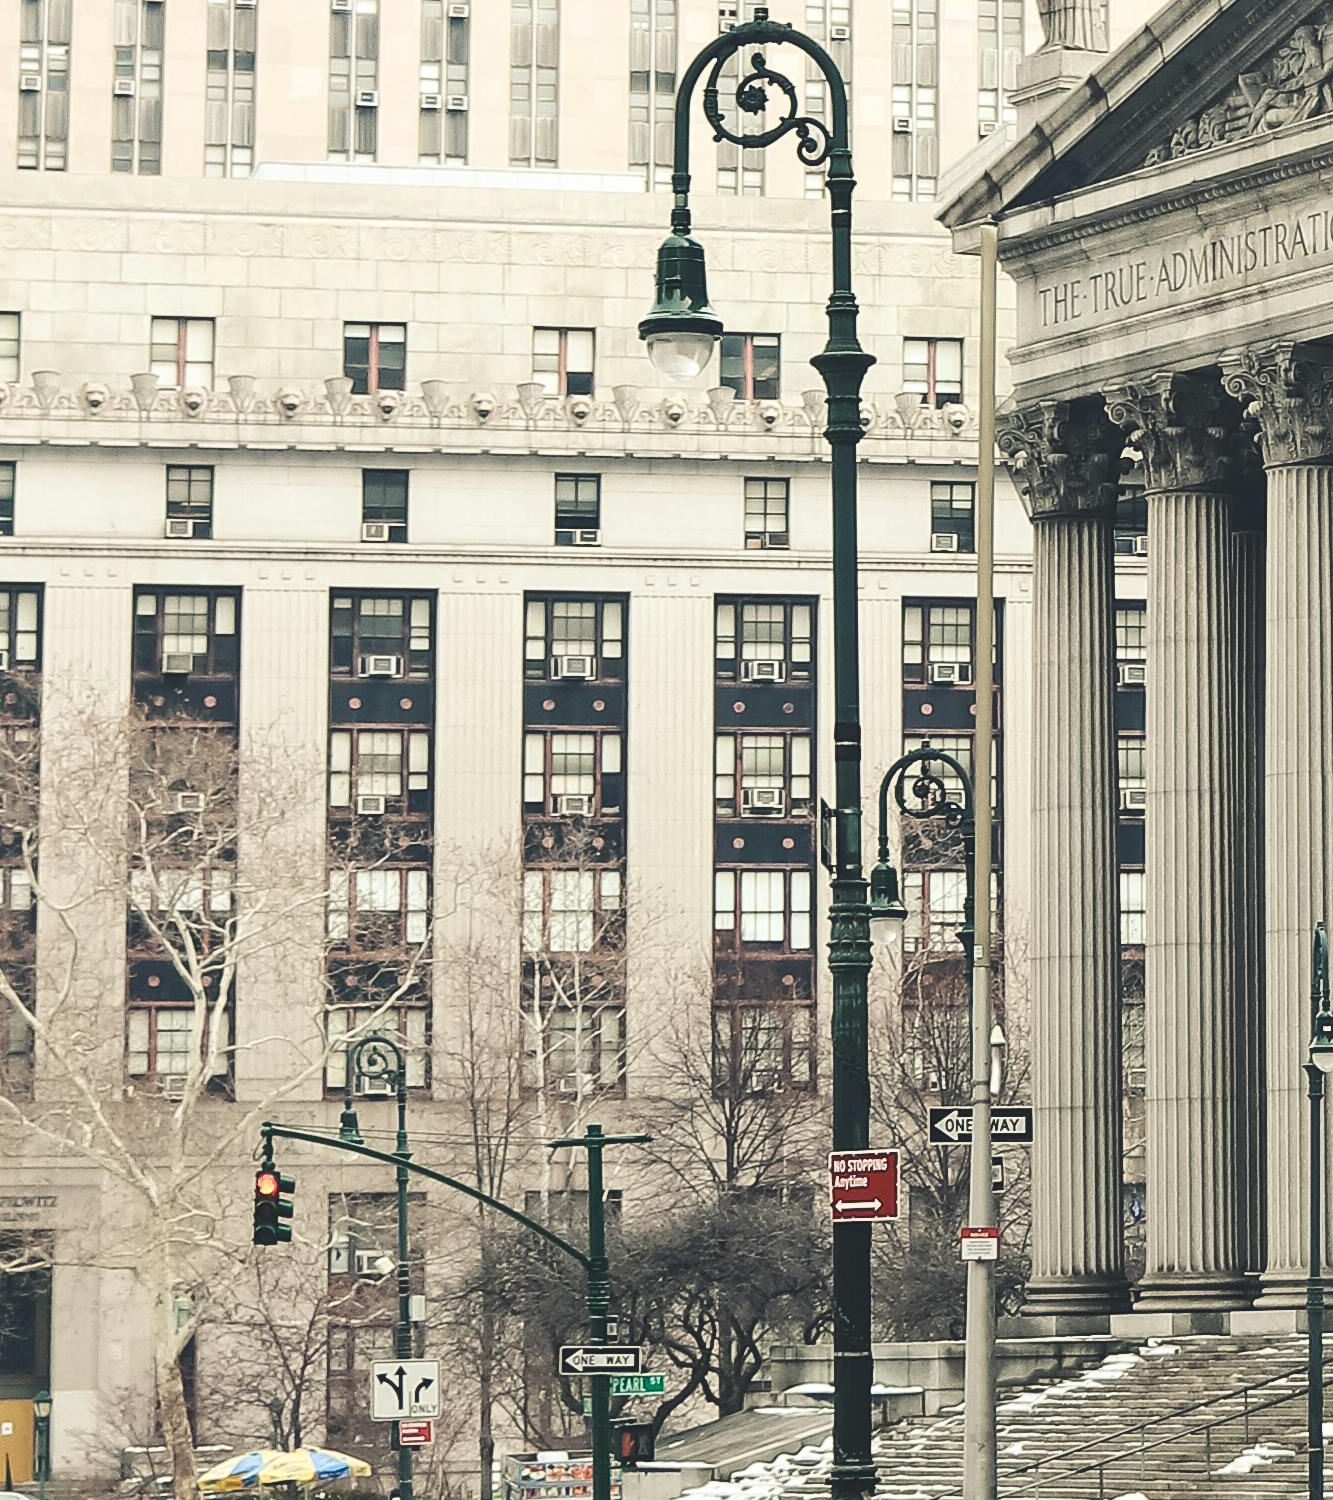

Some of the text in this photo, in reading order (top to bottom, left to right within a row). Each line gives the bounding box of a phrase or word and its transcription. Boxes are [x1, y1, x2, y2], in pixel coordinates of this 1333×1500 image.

[1039, 279, 1082, 326] THE
[1089, 262, 1148, 314] TRUE
[945, 1118, 973, 1132] ONE
[833, 1157, 888, 1173] NO STOPPING
[834, 1174, 868, 1190] Anytime
[572, 1355, 630, 1365] ONE WAY
[612, 1376, 661, 1392] PEARL ST
[411, 1404, 437, 1413] ONLY
